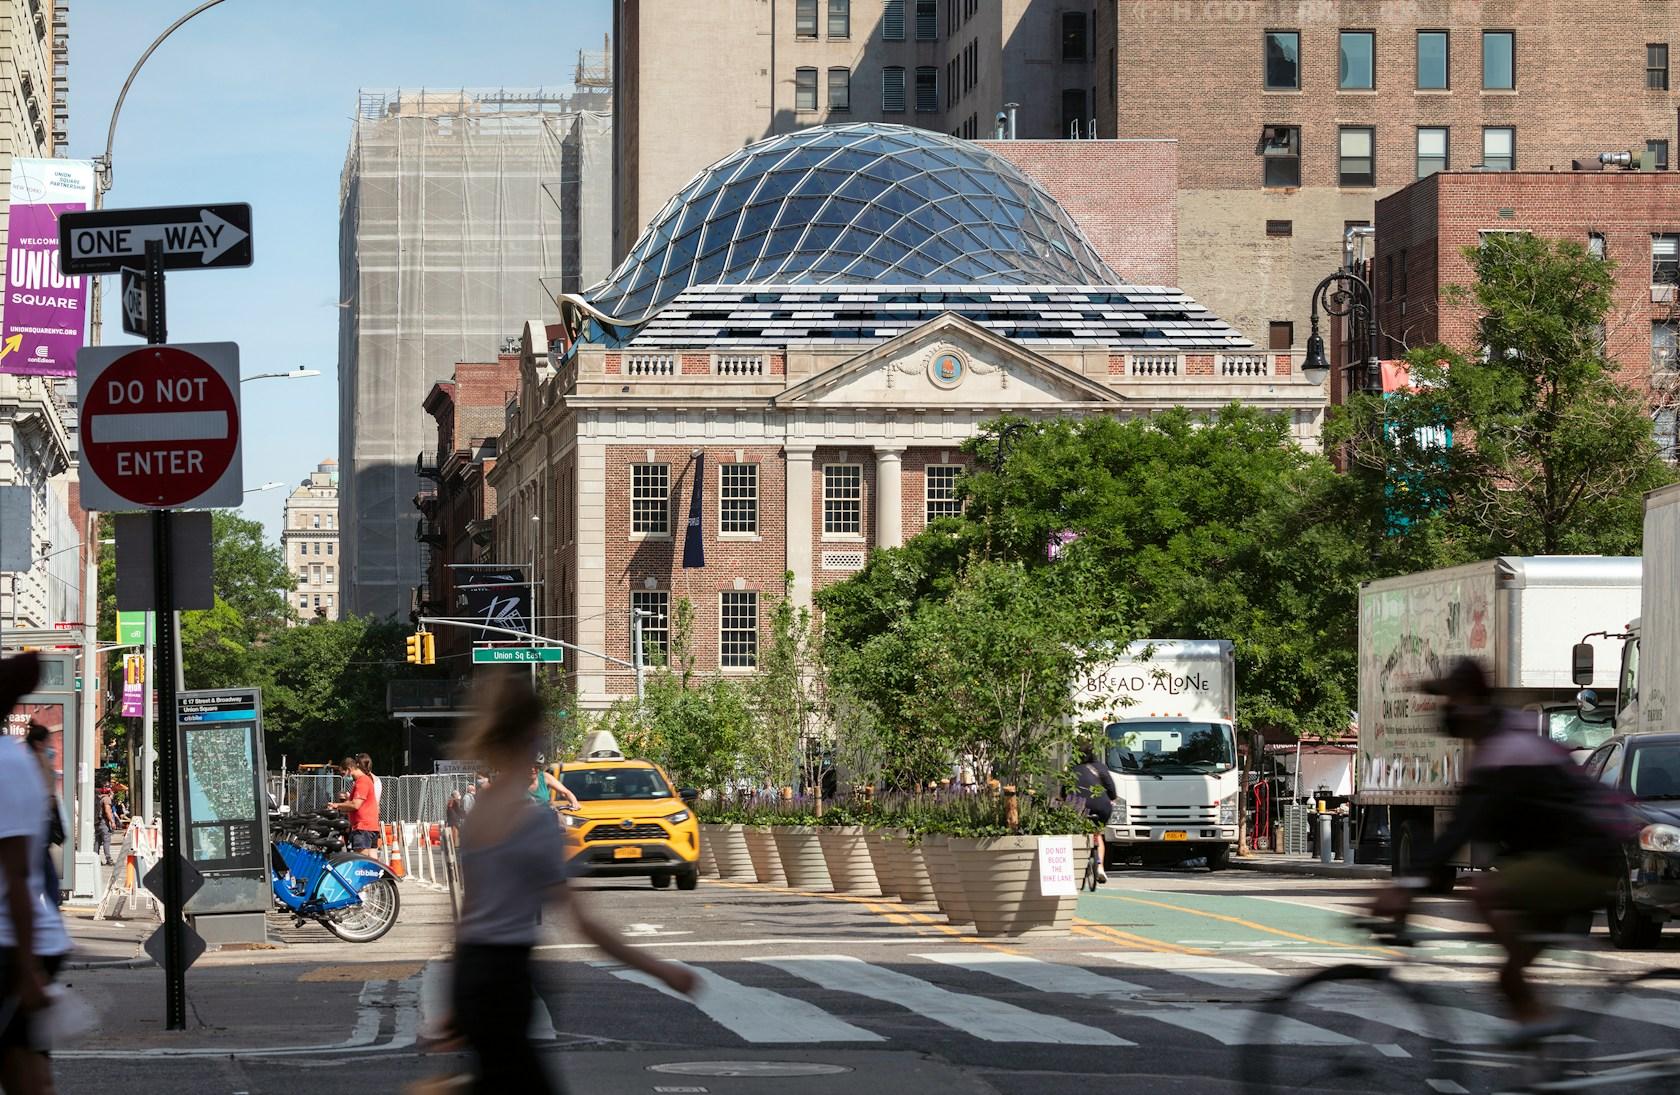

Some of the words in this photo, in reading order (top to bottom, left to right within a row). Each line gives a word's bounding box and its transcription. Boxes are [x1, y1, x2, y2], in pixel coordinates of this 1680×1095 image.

[77, 229, 132, 255] ONE
[165, 224, 225, 250] WAY
[12, 293, 78, 310] SQUARE
[10, 325, 77, 336] UNIONSQUARENYC.ORG
[108, 380, 144, 405] DO
[156, 377, 208, 403] NOT
[117, 450, 204, 476] ENTER
[494, 651, 513, 660] Union
[515, 651, 524, 661] Sq
[526, 651, 541, 660] East
[1087, 674, 1144, 692] BREAD
[9, 713, 31, 724] easy
[10, 724, 25, 736] life
[1048, 856, 1066, 864] BLOCK
